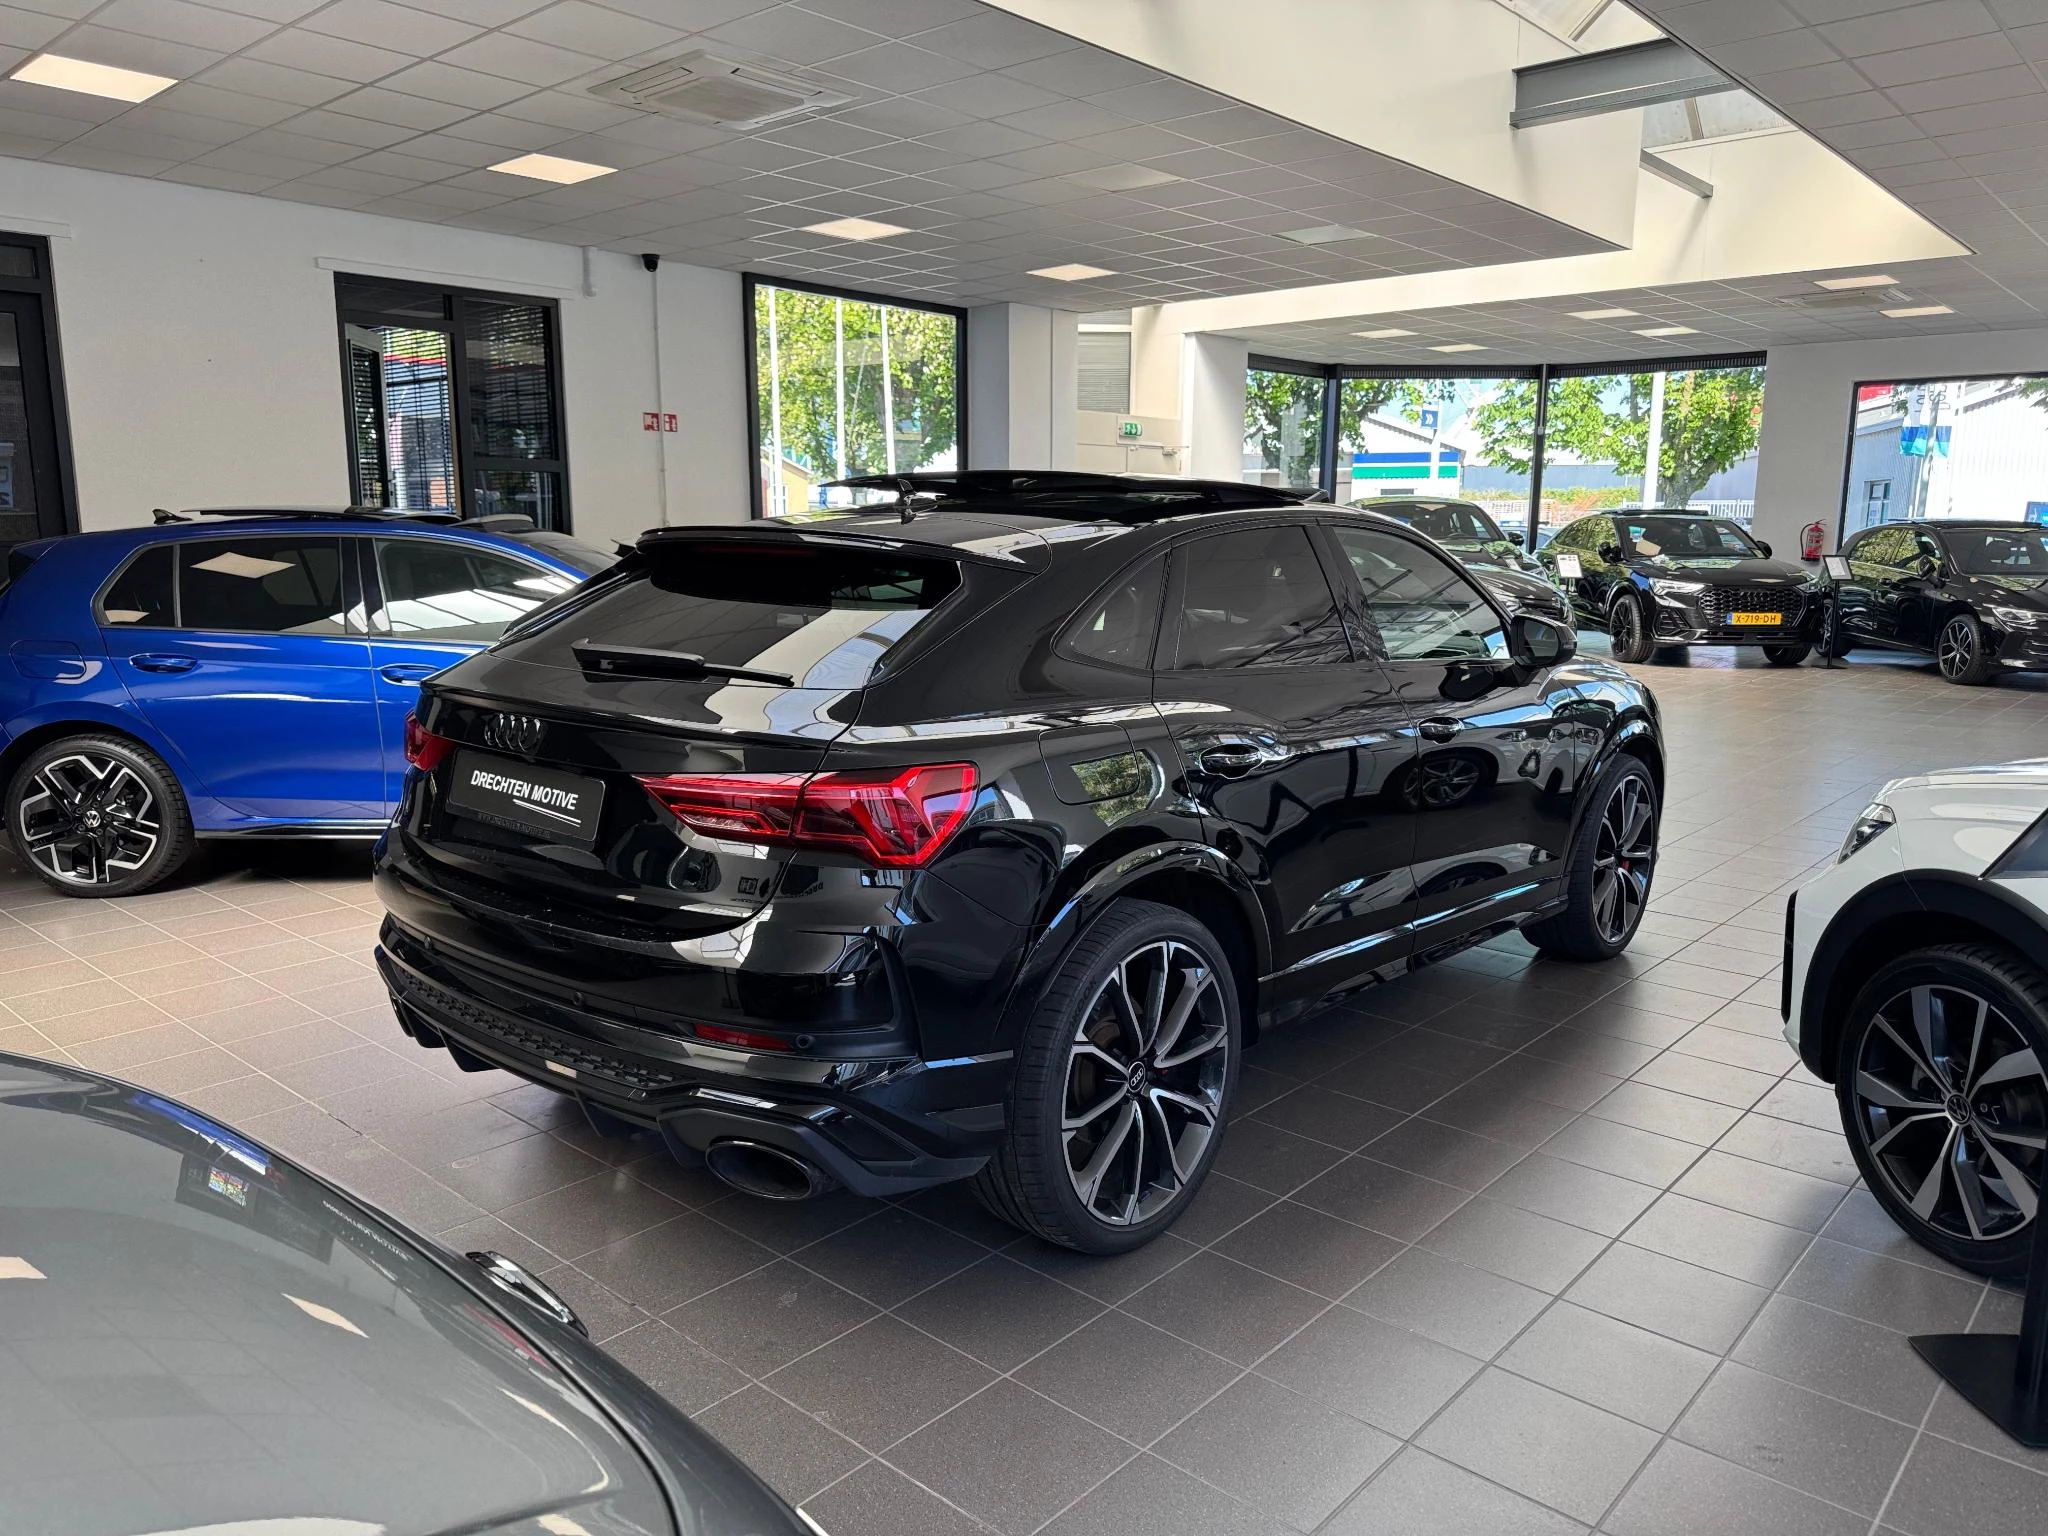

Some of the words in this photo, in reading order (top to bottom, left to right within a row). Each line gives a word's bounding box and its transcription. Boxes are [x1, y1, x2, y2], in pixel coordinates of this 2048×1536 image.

[1735, 614, 1776, 623] X-719-DH
[470, 770, 532, 798] DRECHTEN
[531, 785, 578, 810] MOTIVE
